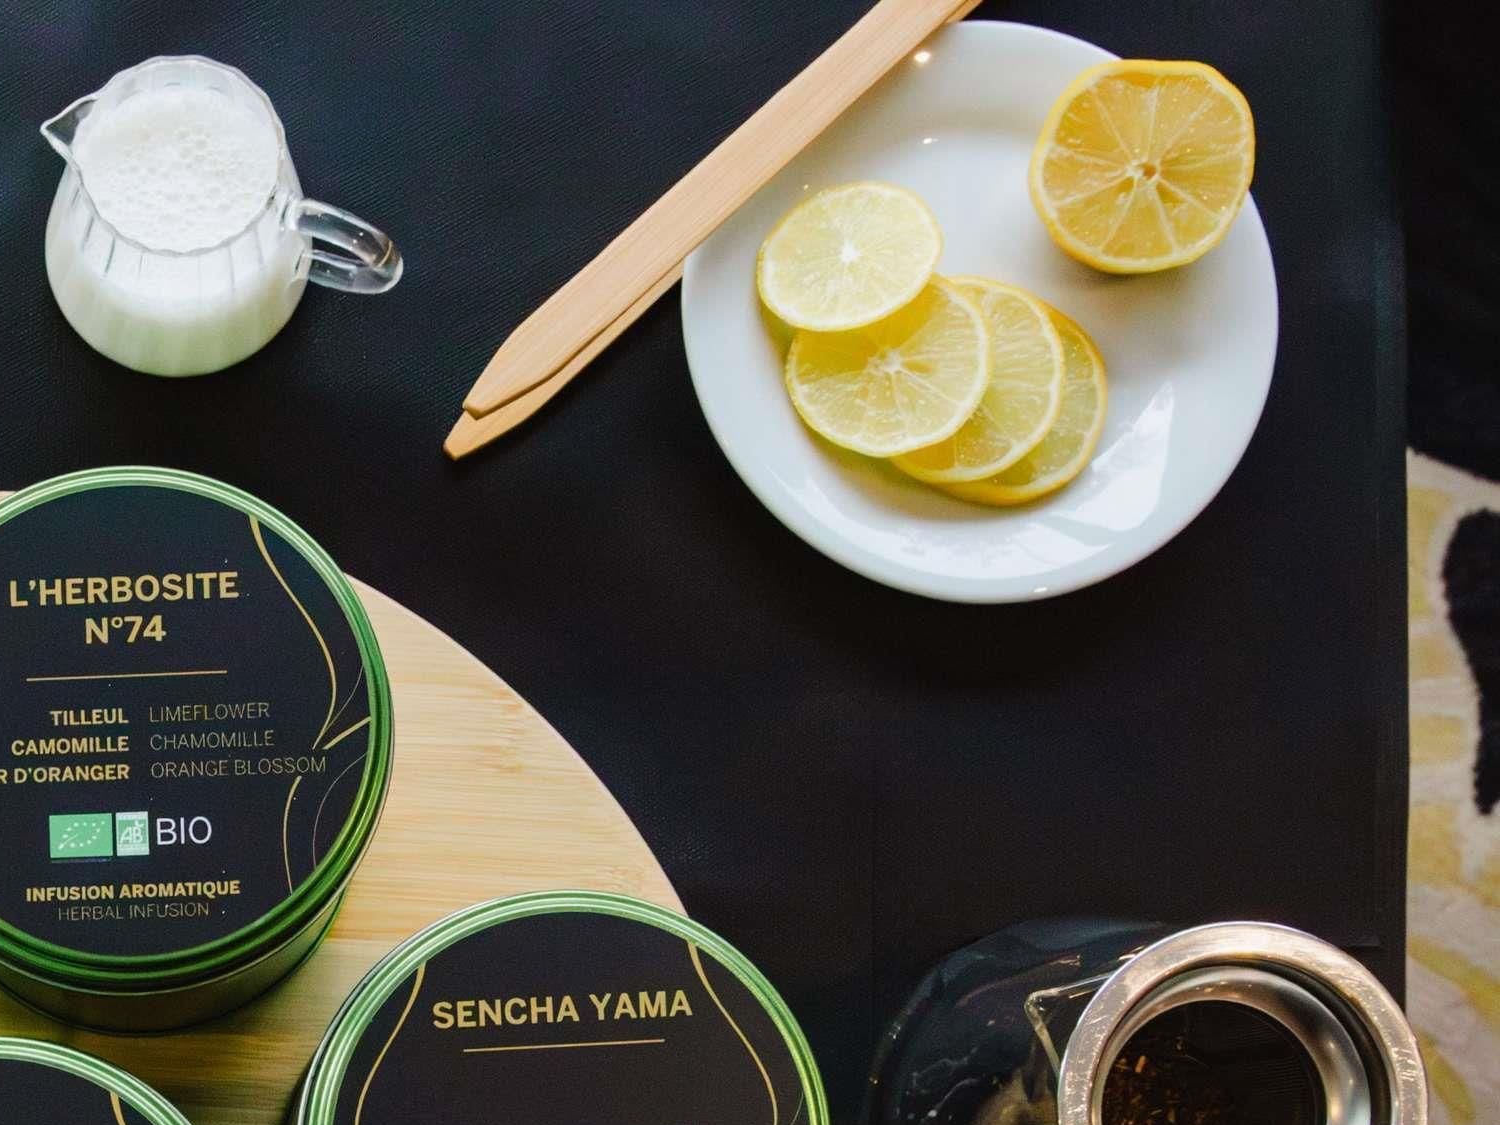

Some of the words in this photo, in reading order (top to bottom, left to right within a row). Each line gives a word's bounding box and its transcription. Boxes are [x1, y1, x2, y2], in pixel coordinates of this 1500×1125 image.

[10, 572, 239, 607] L'HERBOSITE
[86, 615, 166, 644] N°74
[50, 708, 128, 725] TILLEUL
[150, 702, 270, 722] LIMEFLOWER
[12, 736, 129, 755] CAMOMILLE
[150, 730, 273, 750] CHAMOMILLE
[14, 764, 129, 783] D'ORANGER
[151, 759, 227, 778] ORANGE
[234, 756, 325, 778] BLOSSOM
[157, 816, 212, 845] BIO
[27, 885, 114, 901] INFUSION
[120, 880, 240, 898] AROMATIQUE
[59, 906, 123, 921] HERBAL
[129, 902, 209, 918] INFUSION
[433, 996, 579, 1028] SENCHA
[589, 990, 692, 1020] YAMA
